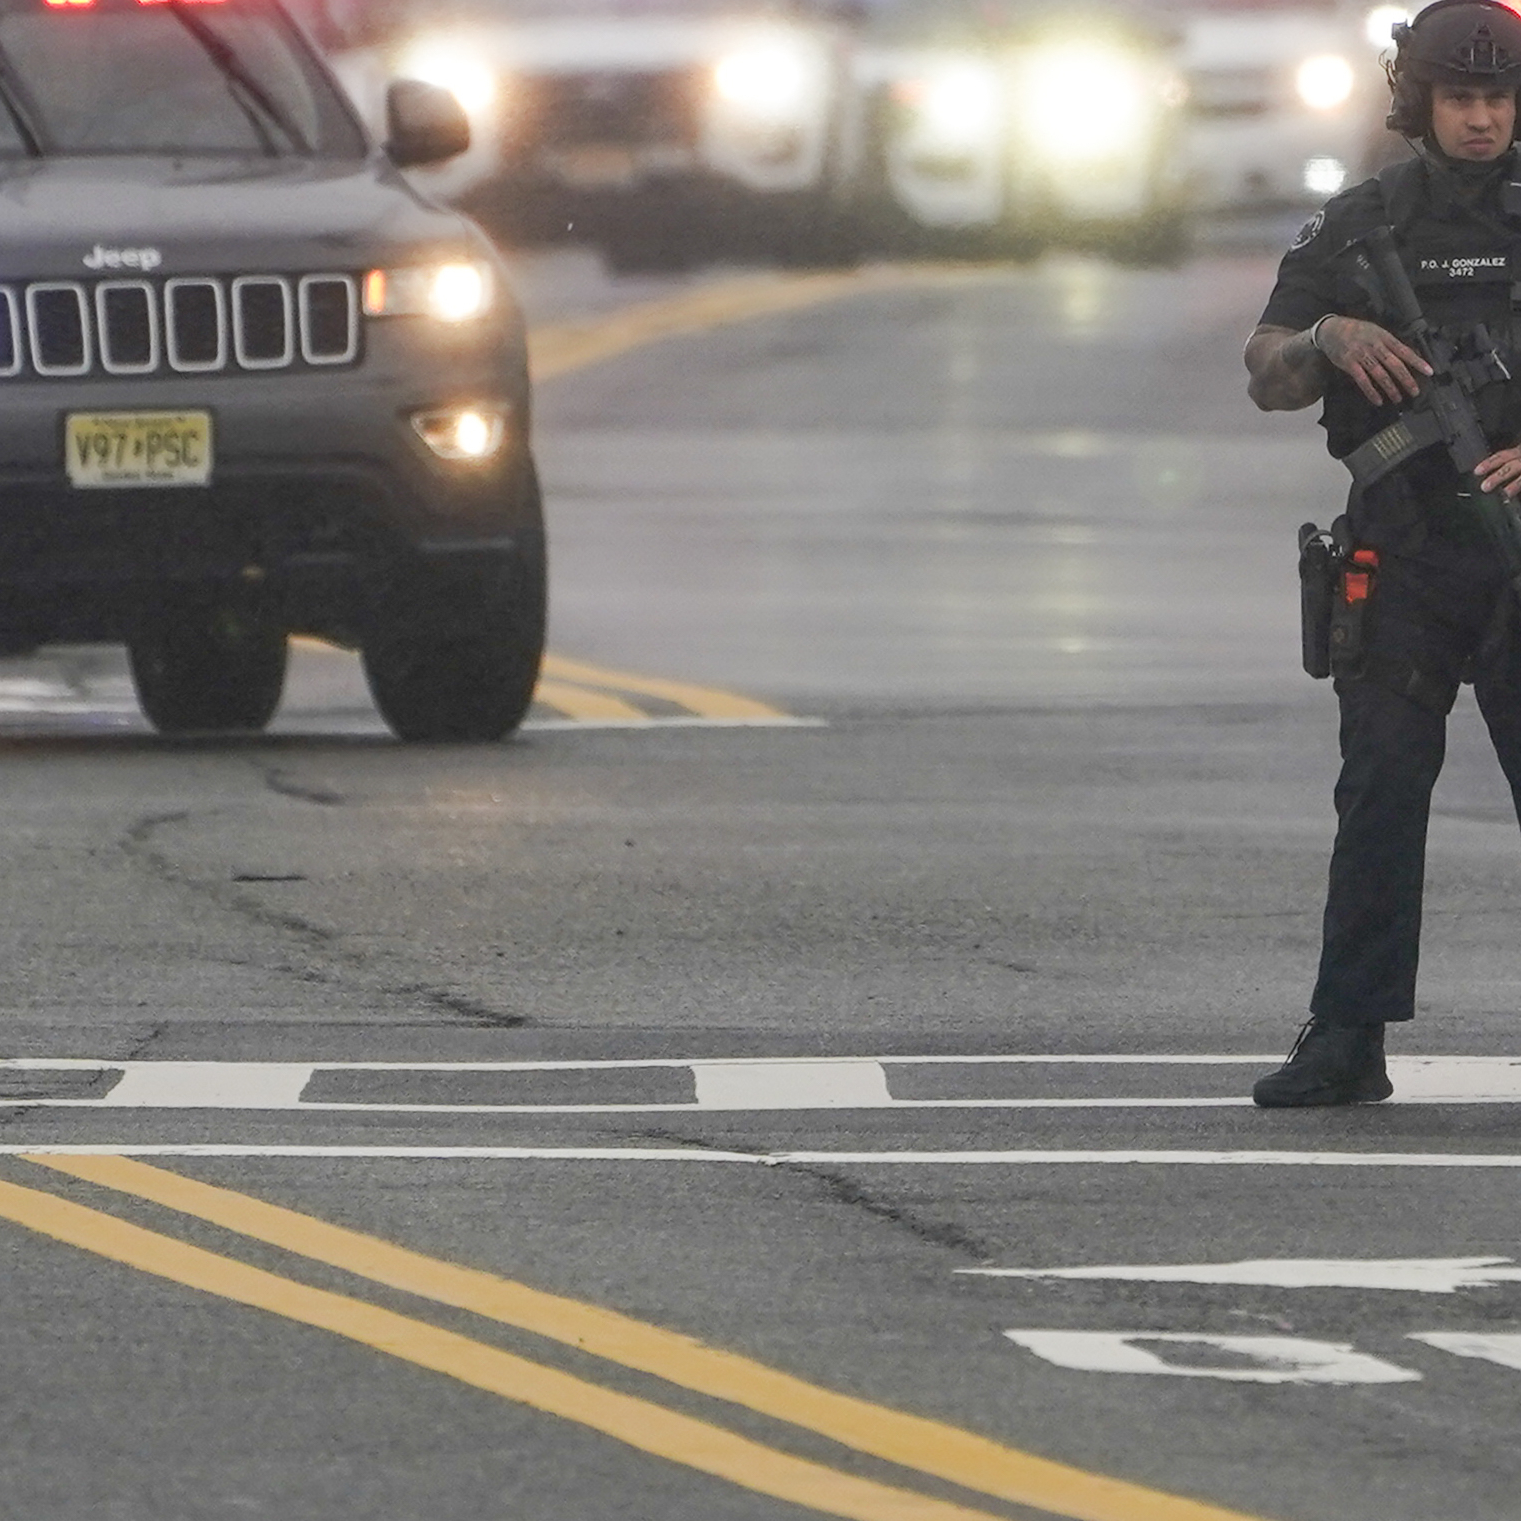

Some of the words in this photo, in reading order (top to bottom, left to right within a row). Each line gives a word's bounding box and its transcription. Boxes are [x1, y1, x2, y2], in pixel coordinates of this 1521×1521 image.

[82, 245, 162, 271] Jeep
[1421, 259, 1439, 269] P.O.
[1452, 257, 1506, 268] GONZALEZ
[1449, 267, 1474, 277] 3472
